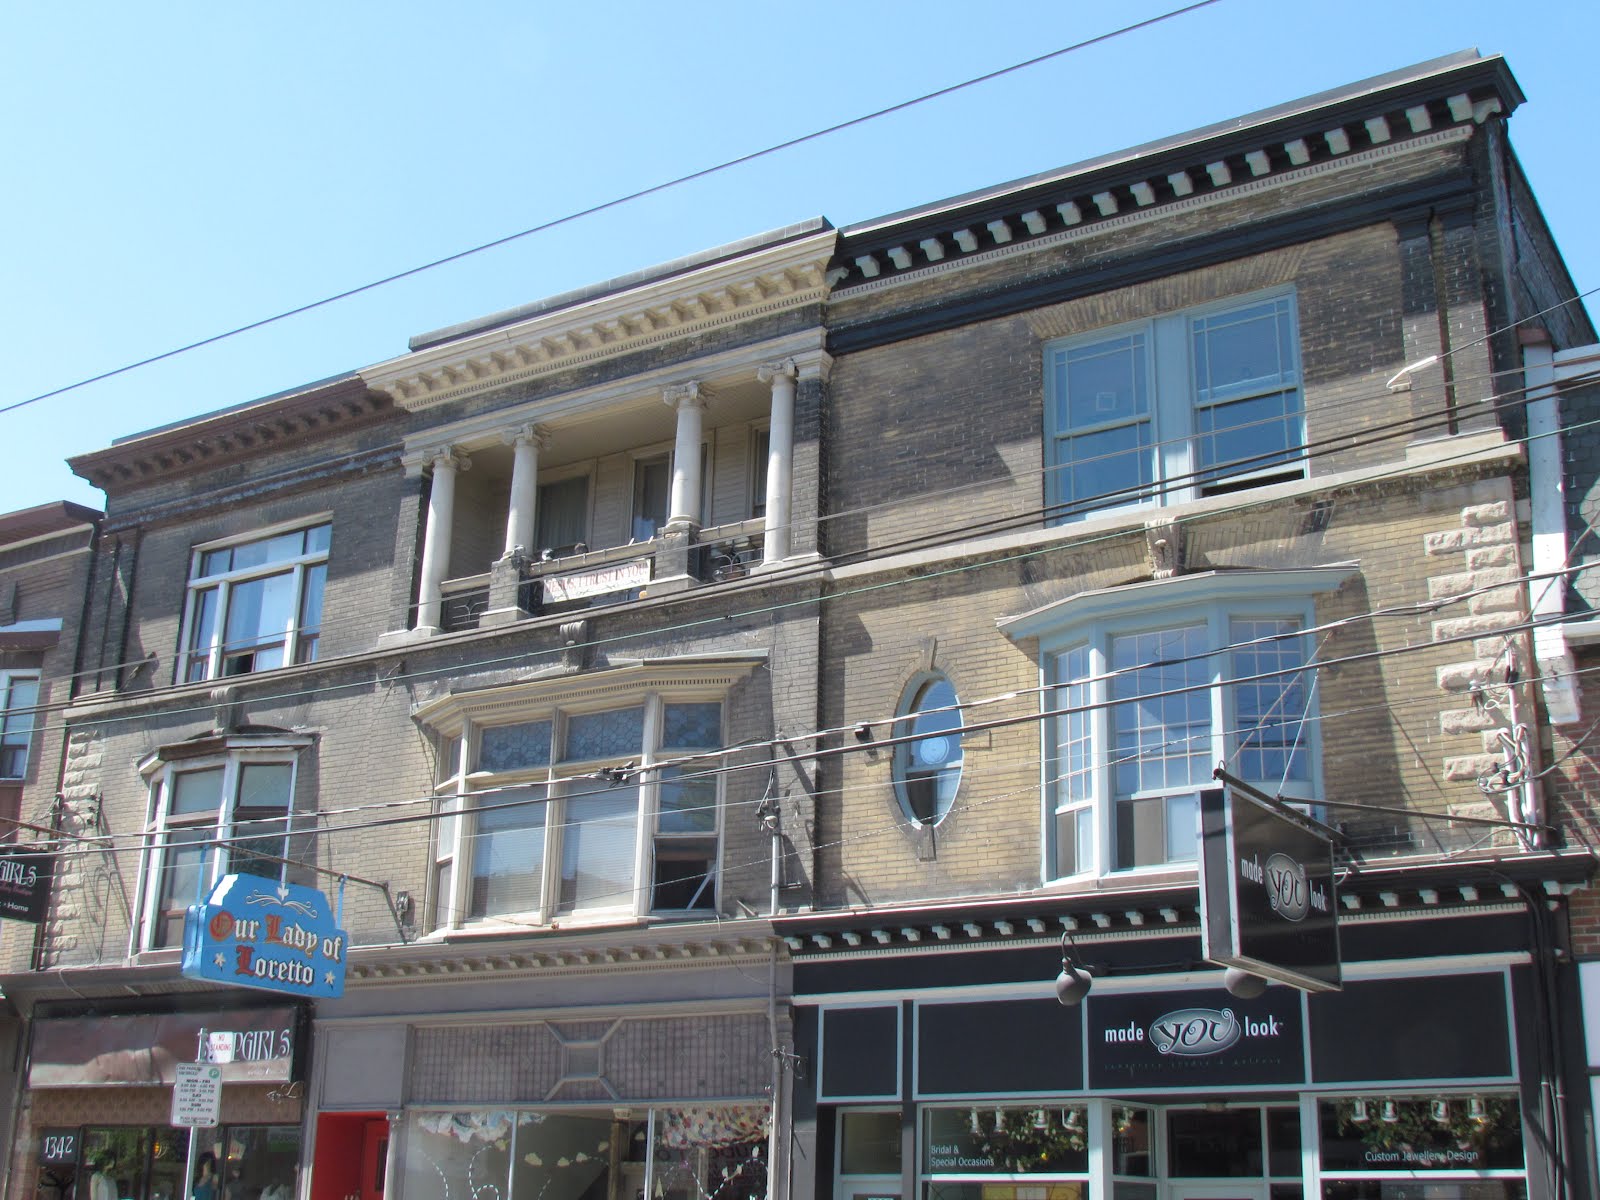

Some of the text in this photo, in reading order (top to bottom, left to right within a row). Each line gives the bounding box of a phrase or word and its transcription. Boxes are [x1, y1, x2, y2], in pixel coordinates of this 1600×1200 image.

[584, 571, 612, 587] TRUST
[615, 567, 624, 581] IN
[1241, 854, 1263, 885] made
[1309, 879, 1328, 912] look
[7, 902, 29, 912] Home
[209, 911, 342, 963] Our Lady of
[235, 945, 315, 987] Loretto
[1104, 1021, 1144, 1042] made
[44, 1135, 74, 1159] 1342
[931, 1145, 960, 1154] Bridal &
[1365, 1150, 1479, 1163] Custom Jewellery Design
[931, 1157, 995, 1168] Special Occasions
